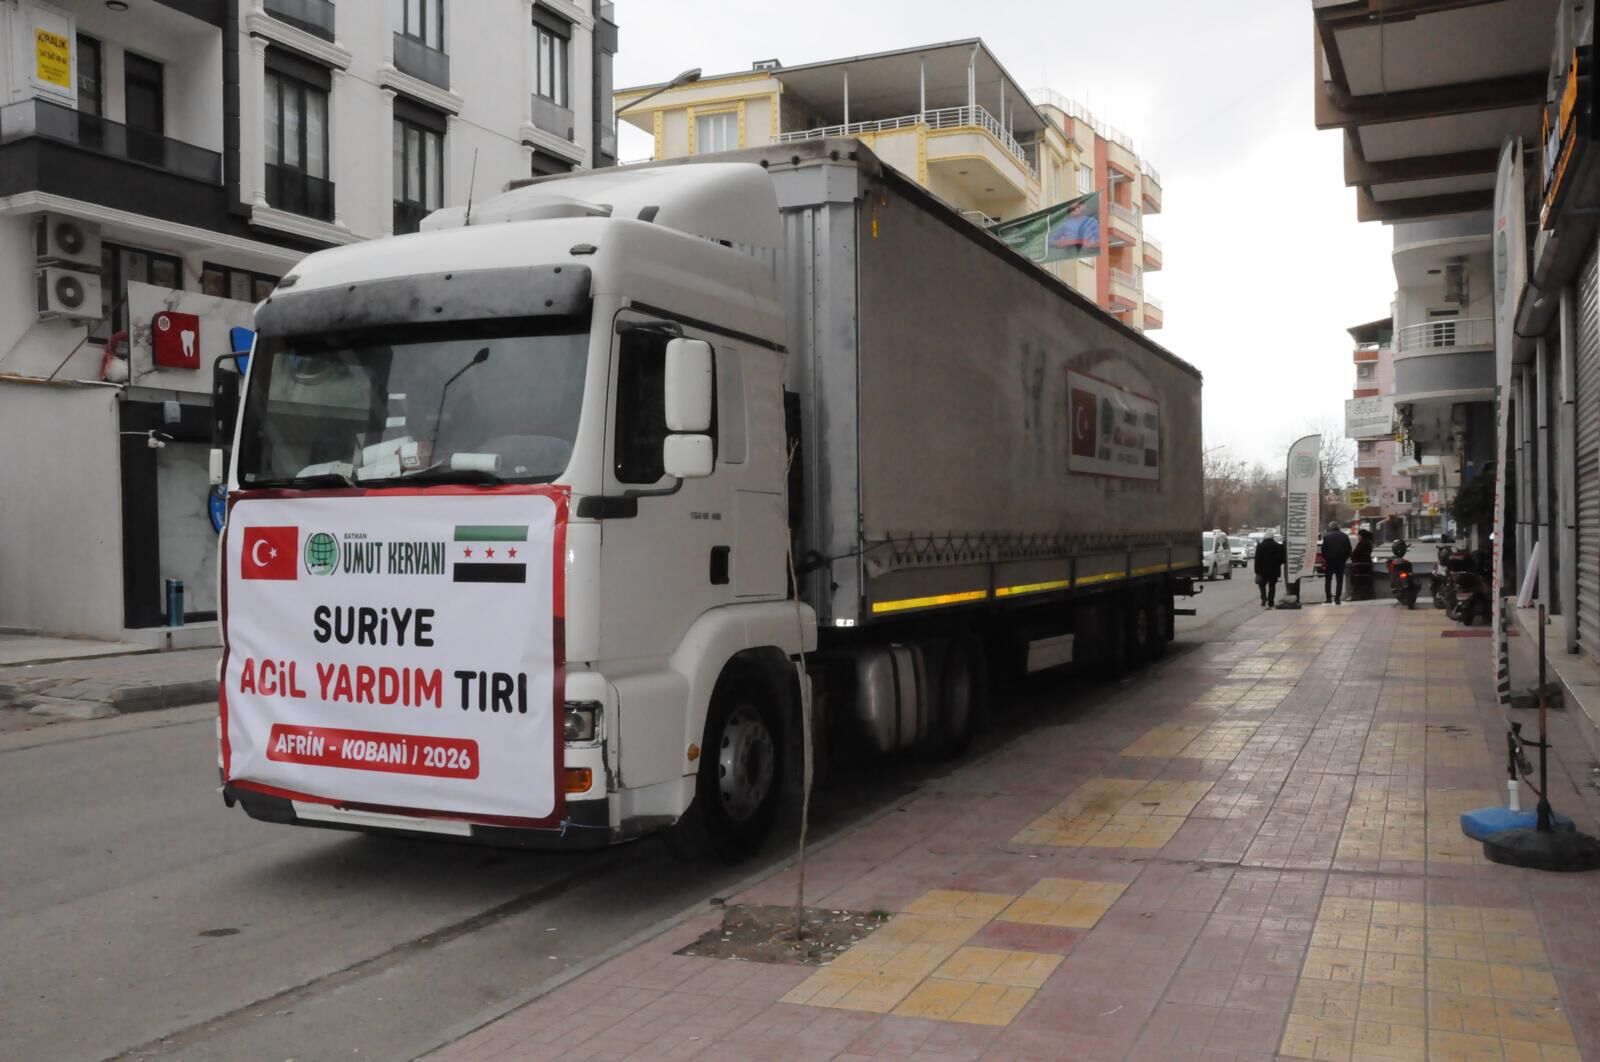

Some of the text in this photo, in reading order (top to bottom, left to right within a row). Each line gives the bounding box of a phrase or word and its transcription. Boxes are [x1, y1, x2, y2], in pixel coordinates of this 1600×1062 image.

[1288, 492, 1308, 538] KERVANI
[343, 532, 368, 540] BATMAN
[343, 542, 446, 575] UMUT KERVANI
[316, 662, 443, 709] YARDIM
[453, 670, 528, 714] TIRI
[275, 731, 325, 757] AFRİN
[341, 738, 408, 765] KOBANİ
[423, 746, 472, 770] 2026
